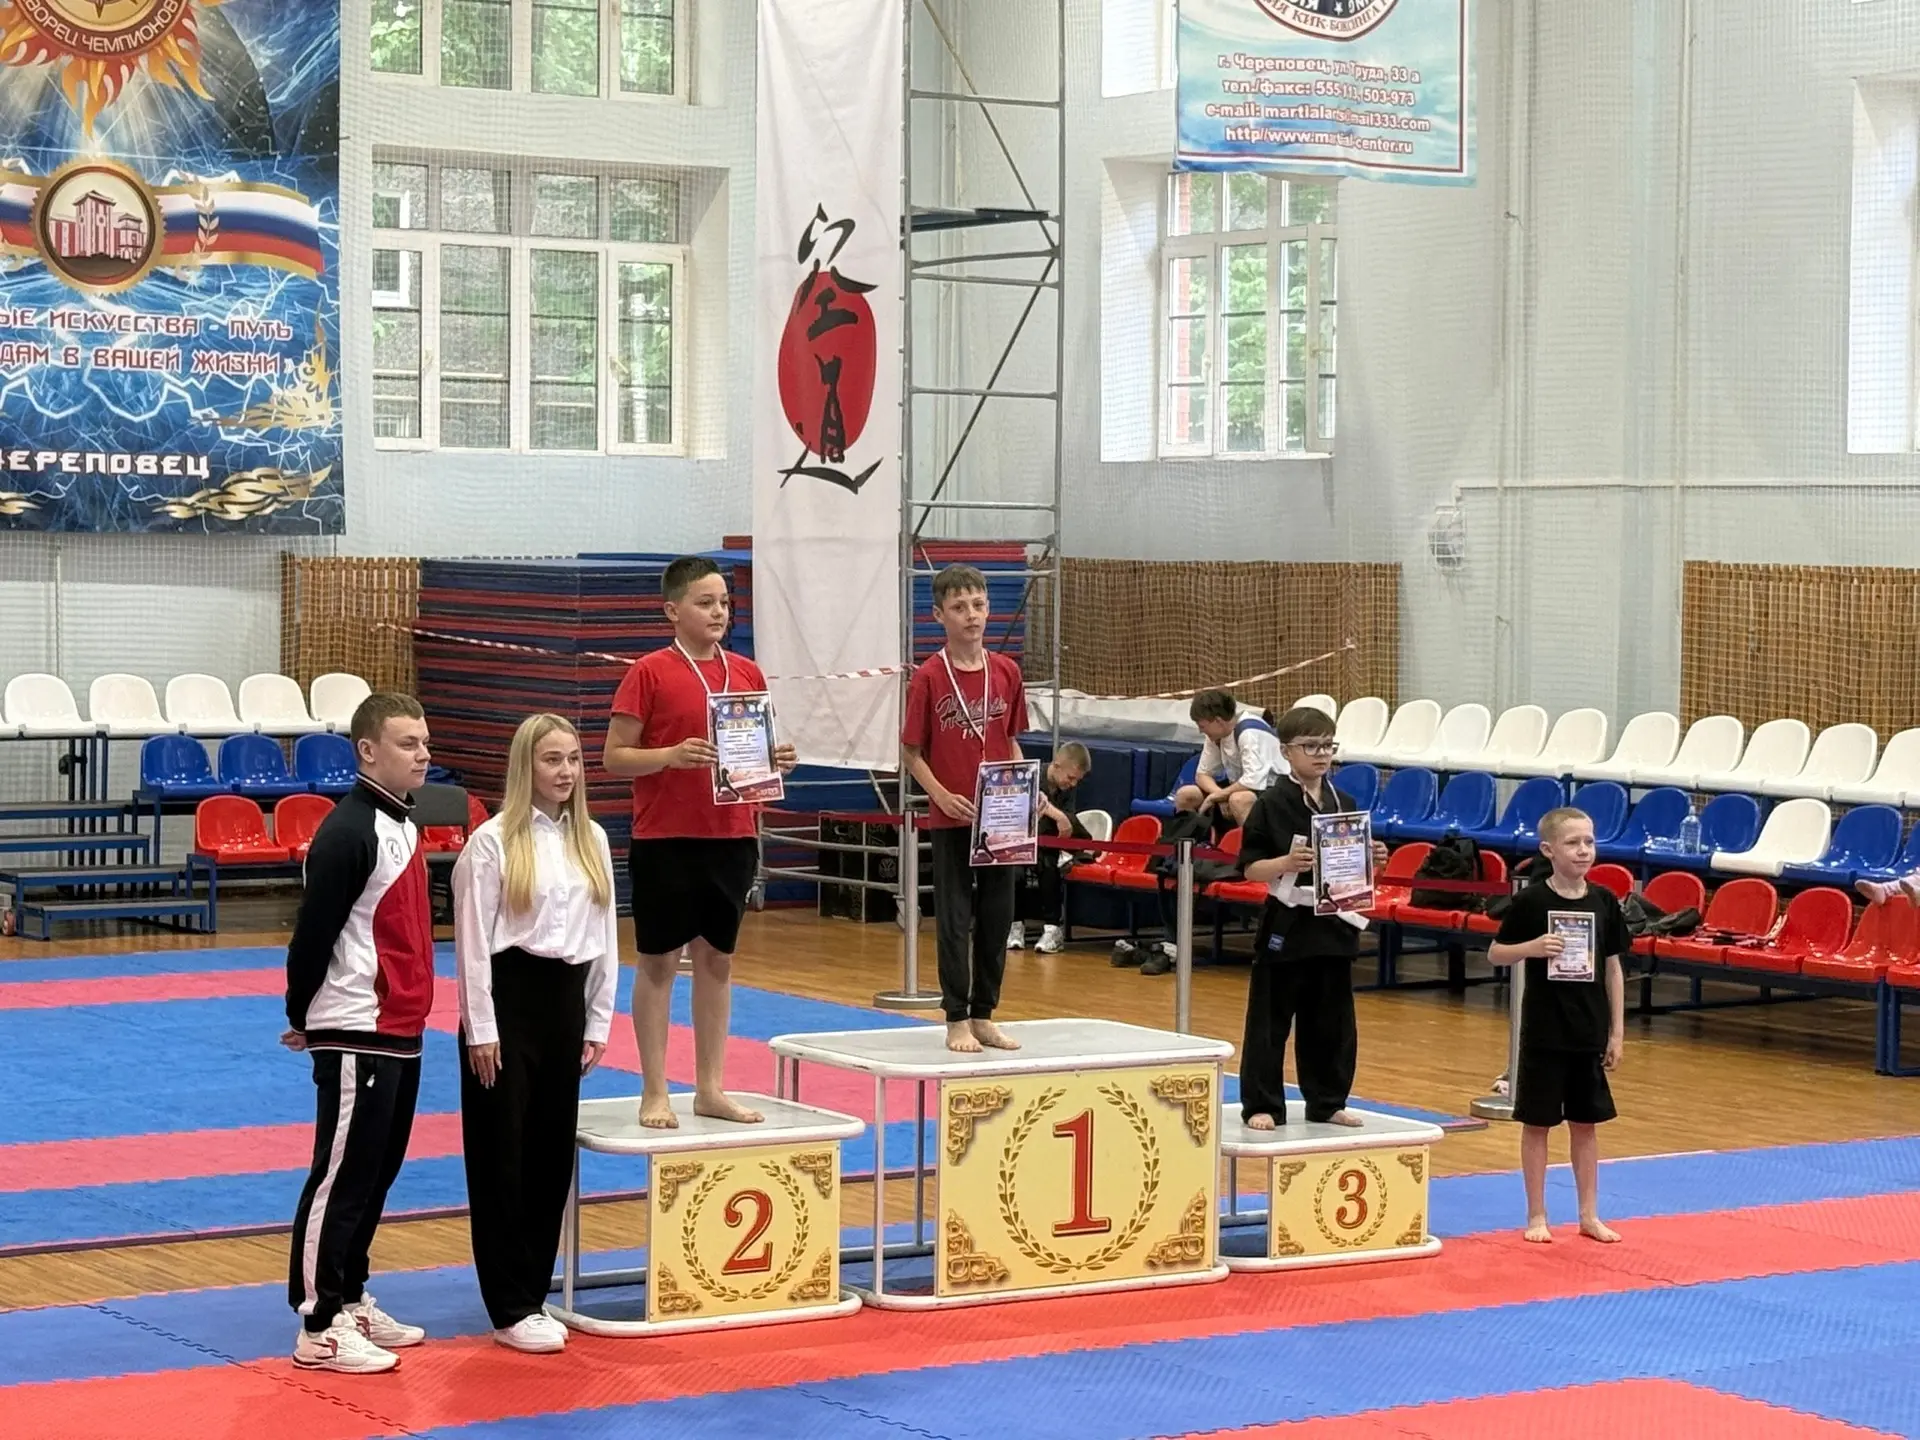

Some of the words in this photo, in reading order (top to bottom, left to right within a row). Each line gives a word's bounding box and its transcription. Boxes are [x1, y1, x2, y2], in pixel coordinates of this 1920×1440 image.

[81, 0, 179, 53] ЧЕМПИОНОВ
[1218, 55, 1231, 68] г.
[1233, 53, 1332, 74] Череповец,
[1391, 66, 1409, 82] 33
[1205, 103, 1260, 118] e-mail:
[1363, 87, 1416, 107] 503-973
[50, 310, 198, 335] ИСКУССТВА
[229, 319, 292, 340] ПУТЬ
[63, 346, 80, 366] В
[93, 345, 182, 371] ВАШЕЙ
[0, 450, 210, 480] ЕРЕПОВЕЦ
[1051, 1106, 1112, 1238] 1
[1336, 1169, 1368, 1230] 3
[720, 1188, 774, 1276] 2
